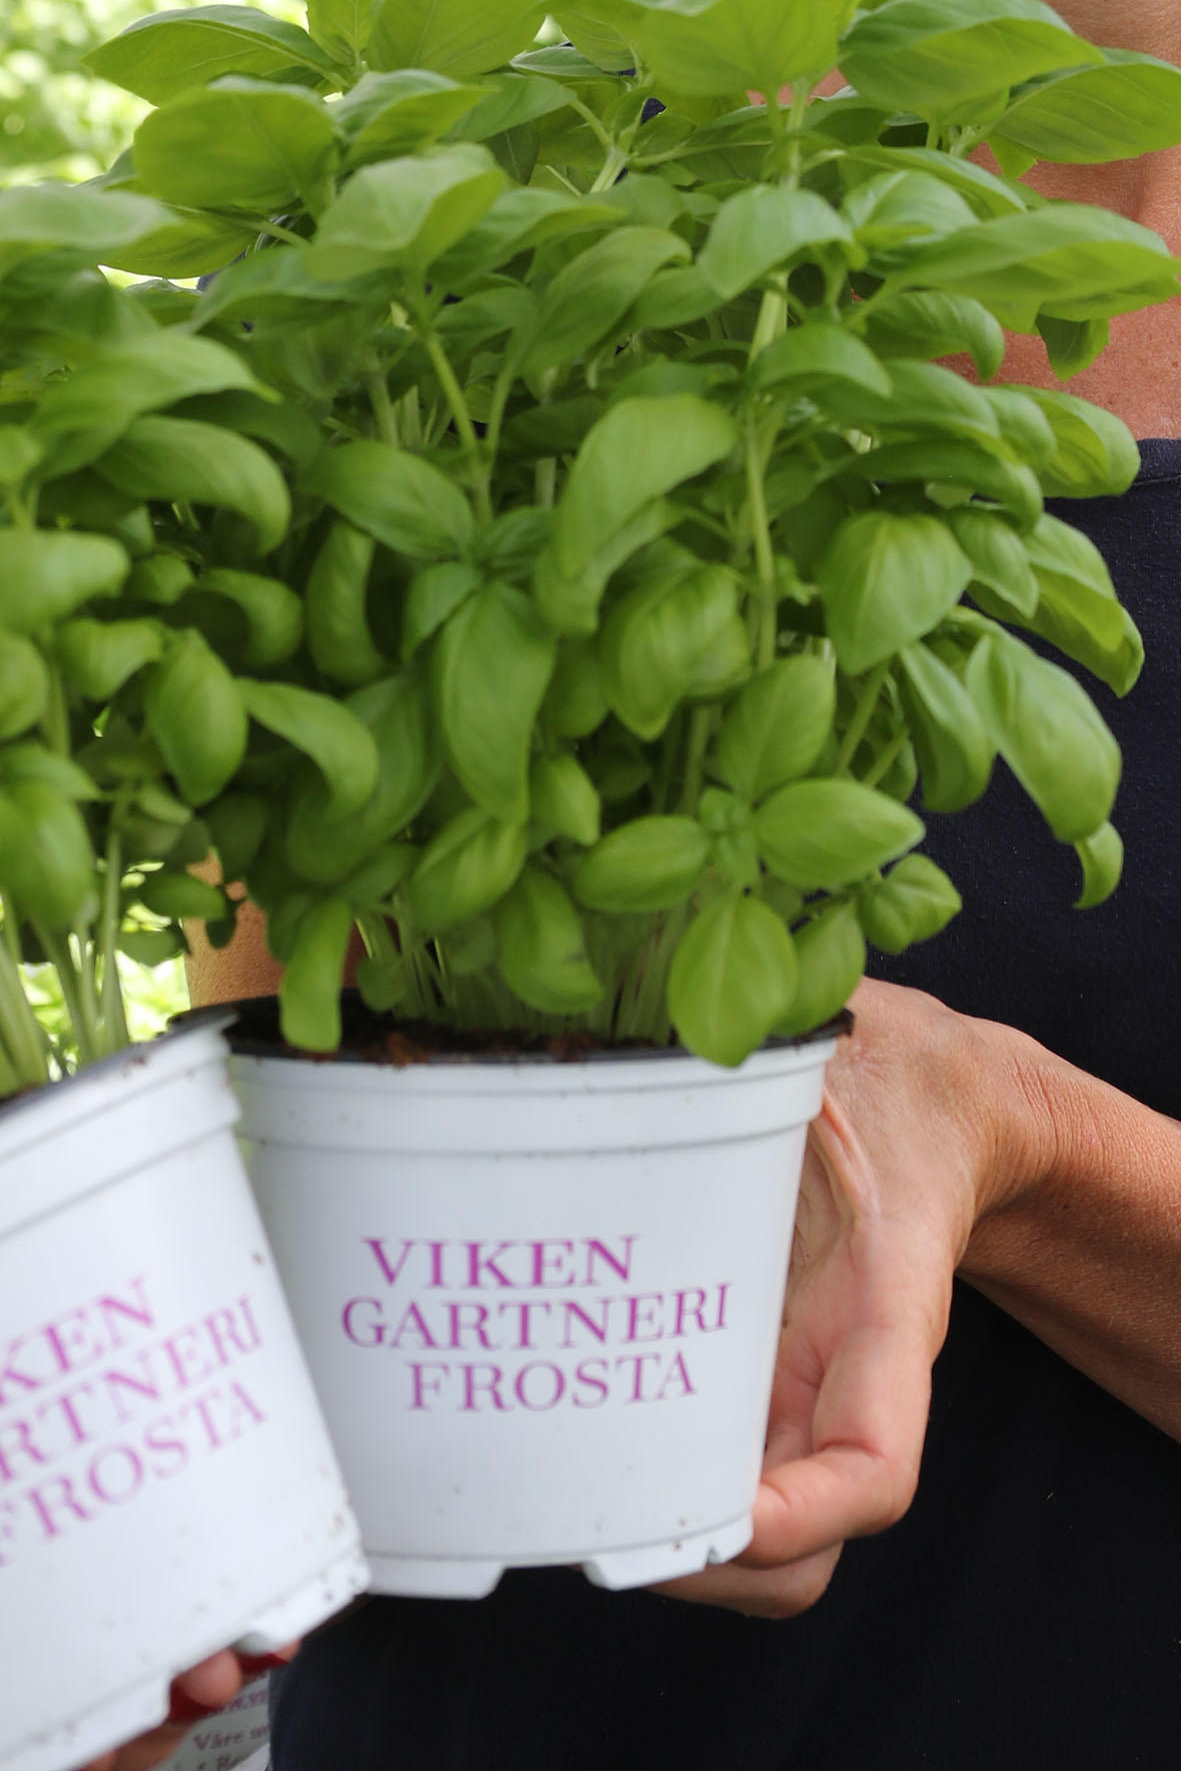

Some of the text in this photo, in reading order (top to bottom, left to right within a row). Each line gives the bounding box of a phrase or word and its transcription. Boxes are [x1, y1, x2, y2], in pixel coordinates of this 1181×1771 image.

[358, 1233, 641, 1290] VIKEN
[340, 1280, 732, 1351] GARTNERI
[404, 1347, 699, 1414] FROSTA
